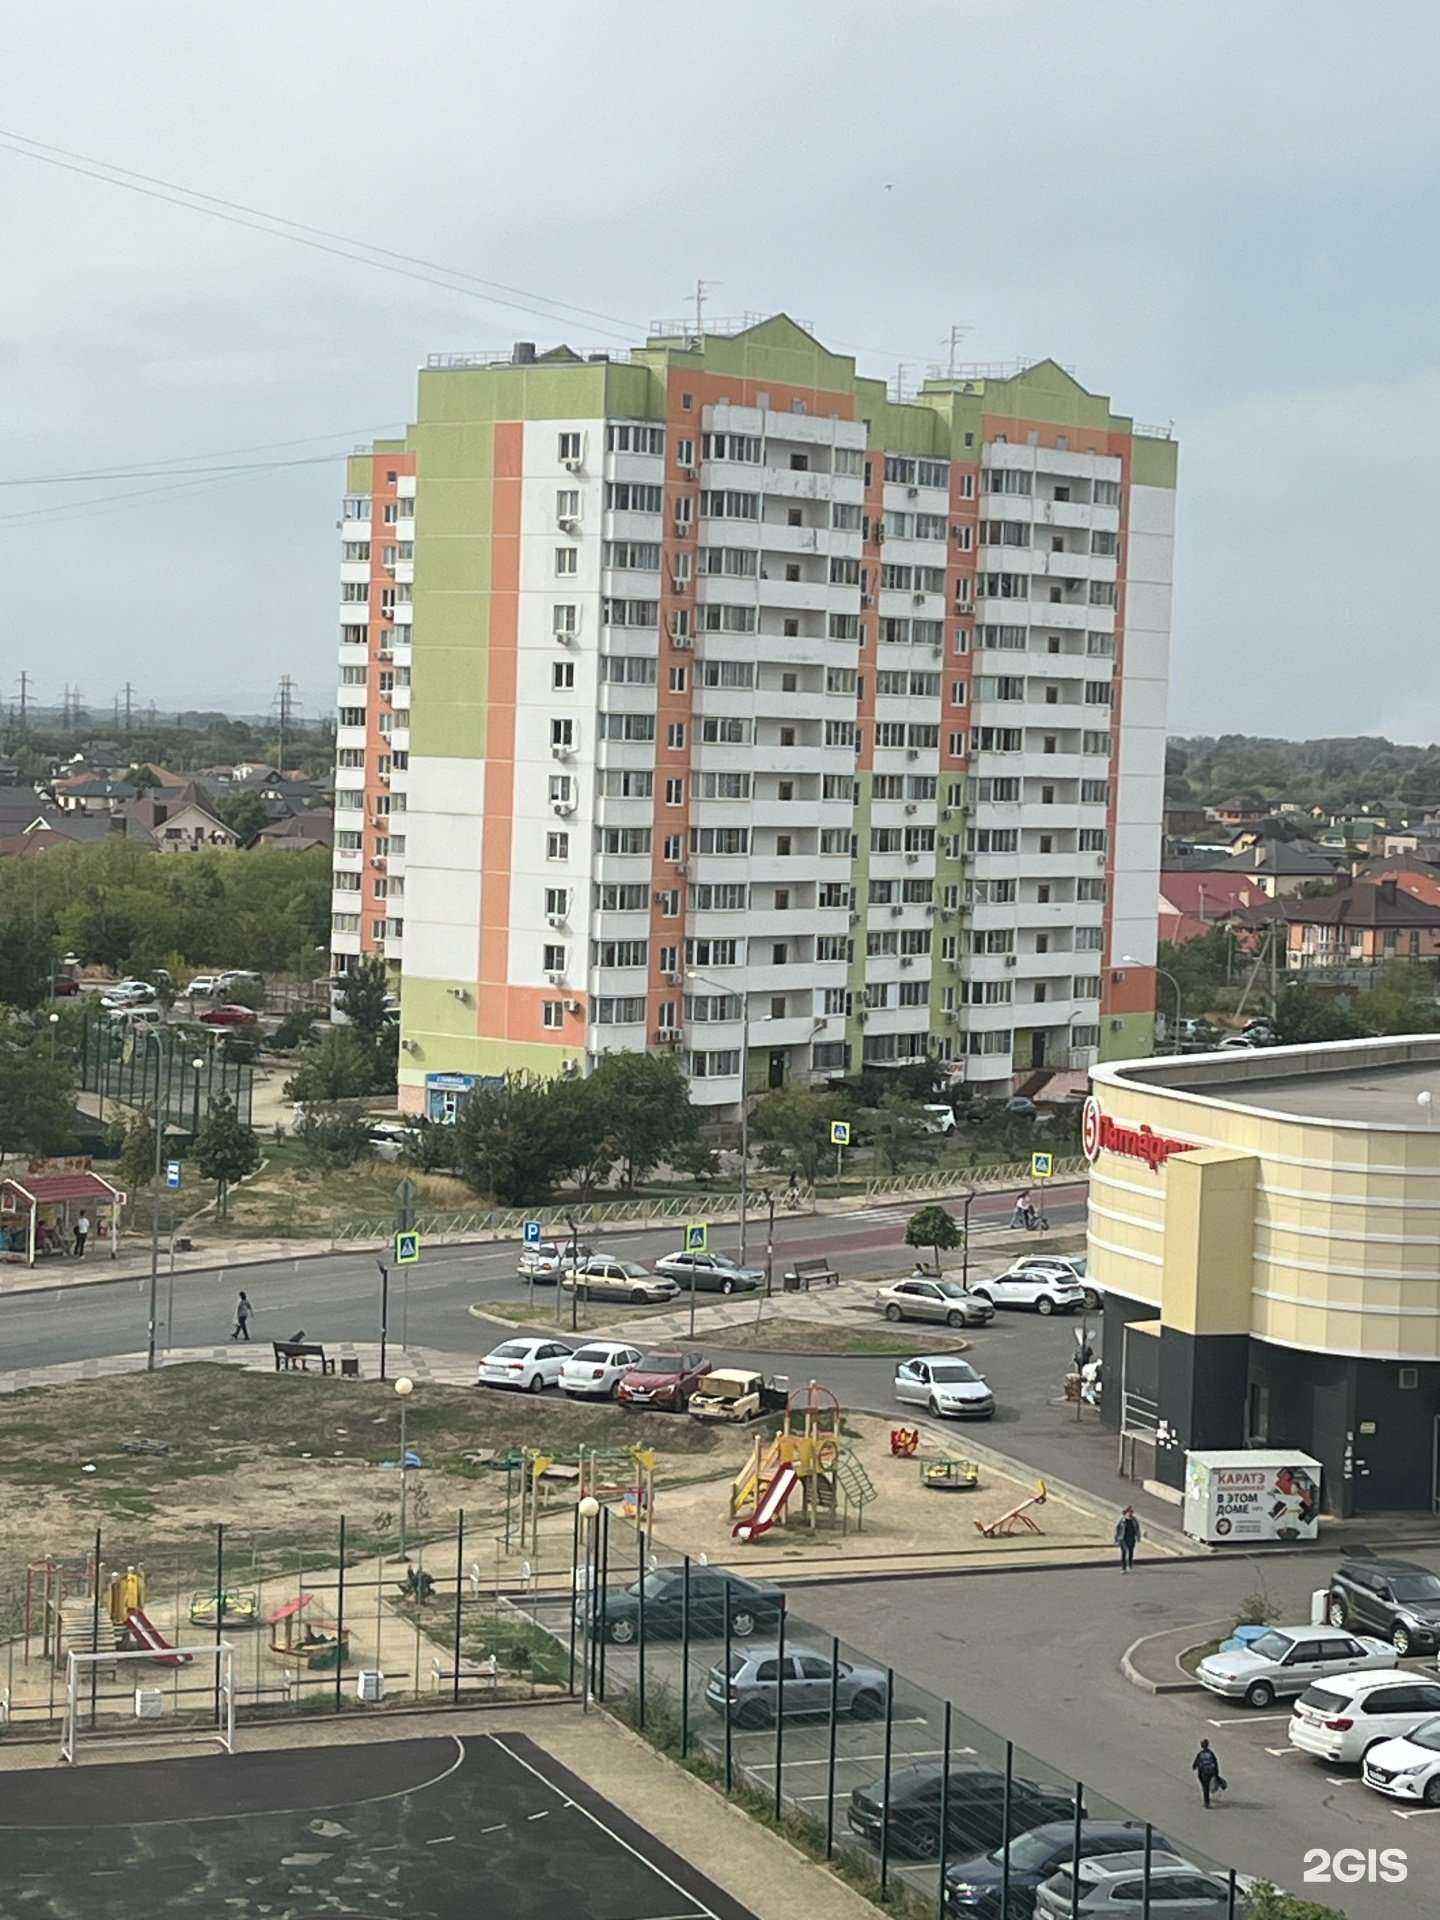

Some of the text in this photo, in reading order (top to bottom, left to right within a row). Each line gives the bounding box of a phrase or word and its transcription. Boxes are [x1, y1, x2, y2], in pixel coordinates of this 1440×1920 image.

[527, 1223, 538, 1241] P
[1217, 1472, 1266, 1485] КАРАТЭ
[1217, 1493, 1258, 1503] В ЭТОМ
[1216, 1504, 1250, 1516] ДОМЕ
